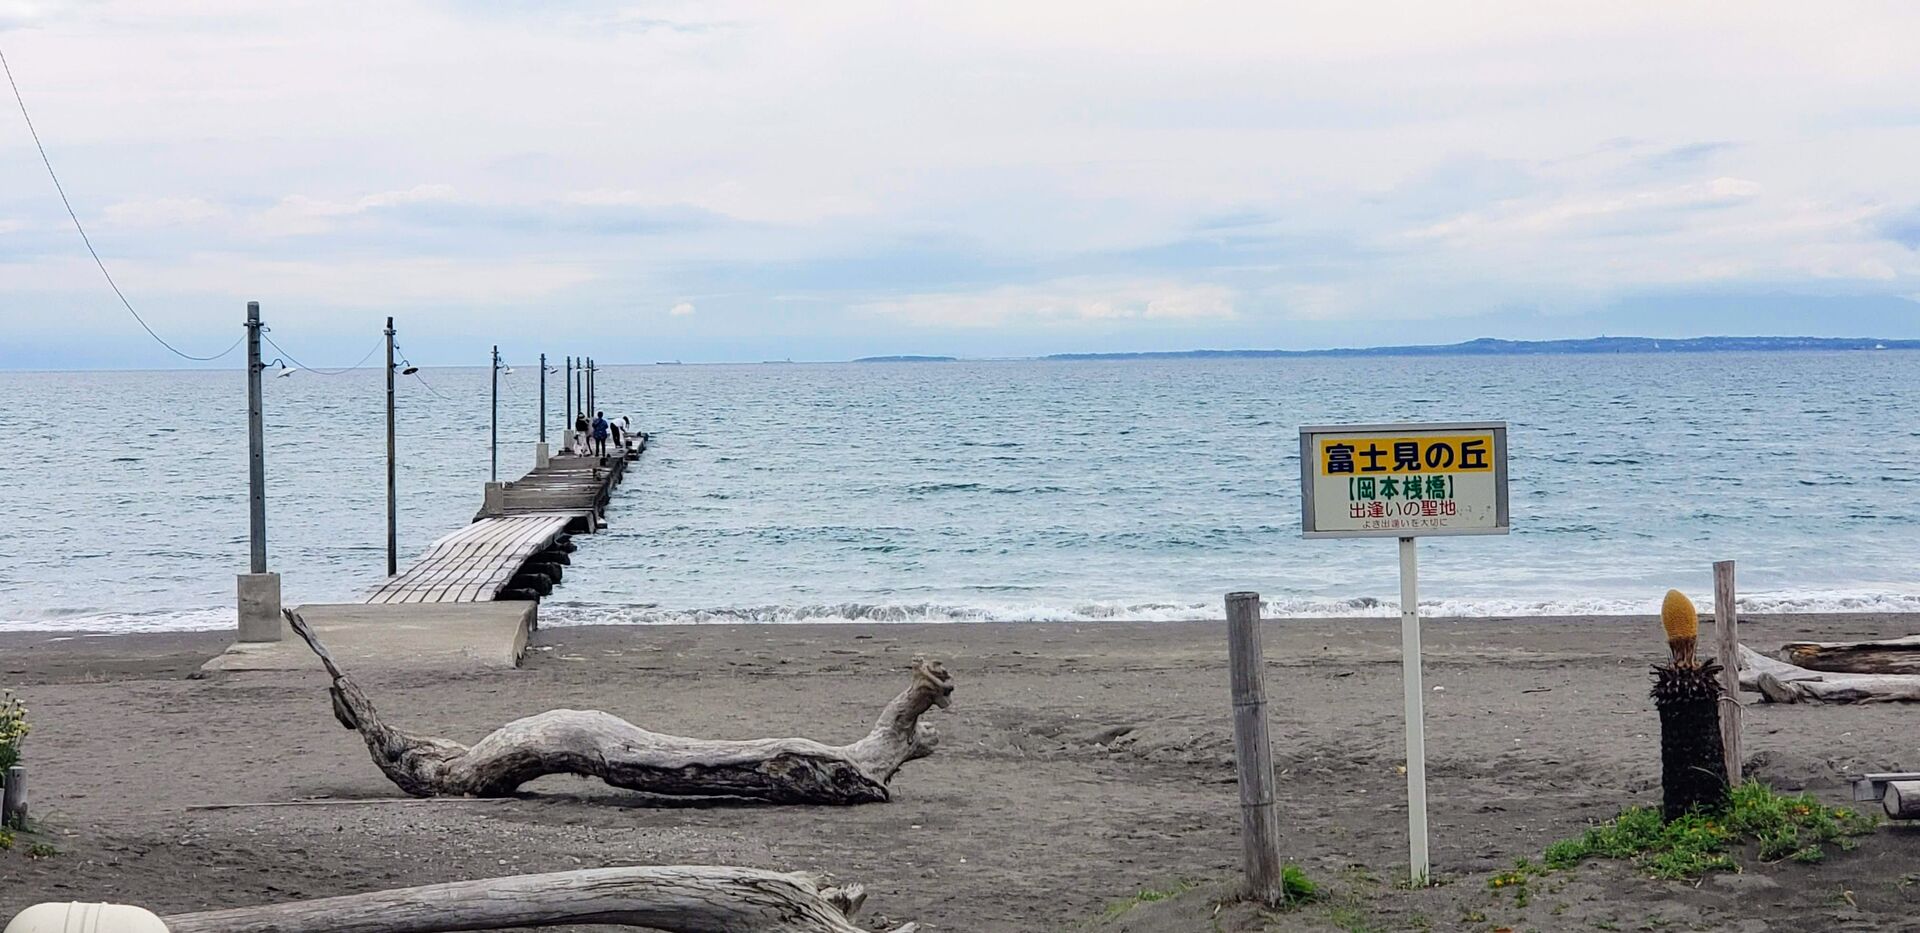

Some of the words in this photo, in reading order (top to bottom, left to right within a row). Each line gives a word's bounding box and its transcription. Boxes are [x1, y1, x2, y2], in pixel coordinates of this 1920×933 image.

[1325, 439, 1489, 474] 富士見の丘
[1349, 499, 1456, 519] 出逢いの聖地
